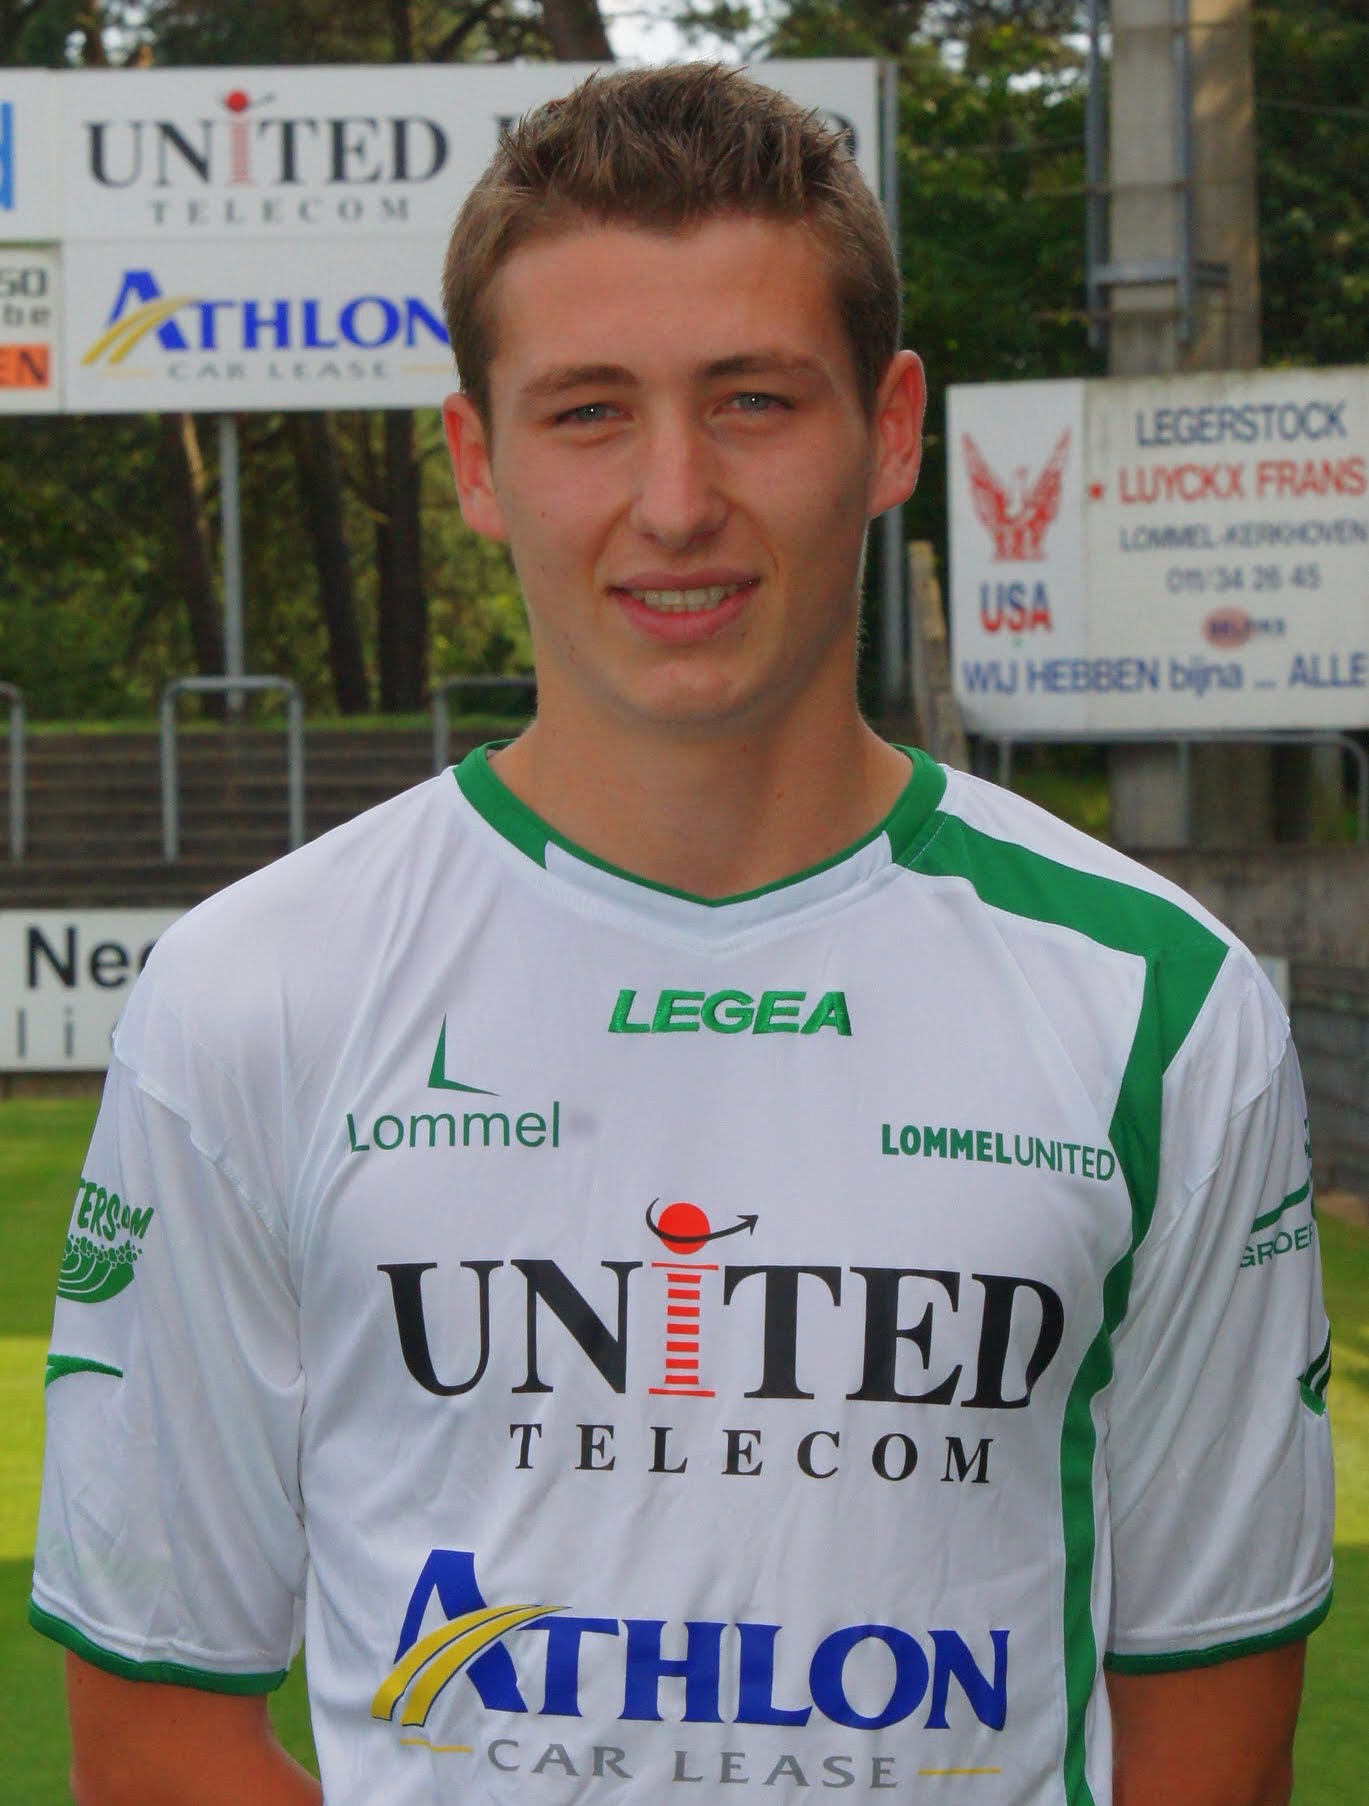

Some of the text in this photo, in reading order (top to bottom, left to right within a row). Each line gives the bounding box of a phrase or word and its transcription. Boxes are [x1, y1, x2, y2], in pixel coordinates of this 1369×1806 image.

[84, 90, 450, 188] UNITED
[152, 199, 410, 226] TELECOM
[106, 269, 450, 351] ATHLON
[168, 359, 390, 381] CAR LEASE
[1136, 401, 1348, 446] LEGERSTOCK
[1118, 456, 1367, 504] LUYCKX FRANS
[979, 580, 1054, 633] USA
[962, 660, 1017, 695] WIJ
[1026, 656, 1160, 693] HEBBEN
[1288, 651, 1369, 690] ALLE
[608, 989, 852, 1036] LEGEA
[346, 1101, 560, 1153] Lommel
[78, 1178, 154, 1241] ERS.OM
[377, 1202, 1065, 1409] UNITED
[509, 1423, 994, 1484] TELECOM
[393, 1549, 1011, 1731] ATHLON
[487, 1739, 898, 1788] CAR LEASE
